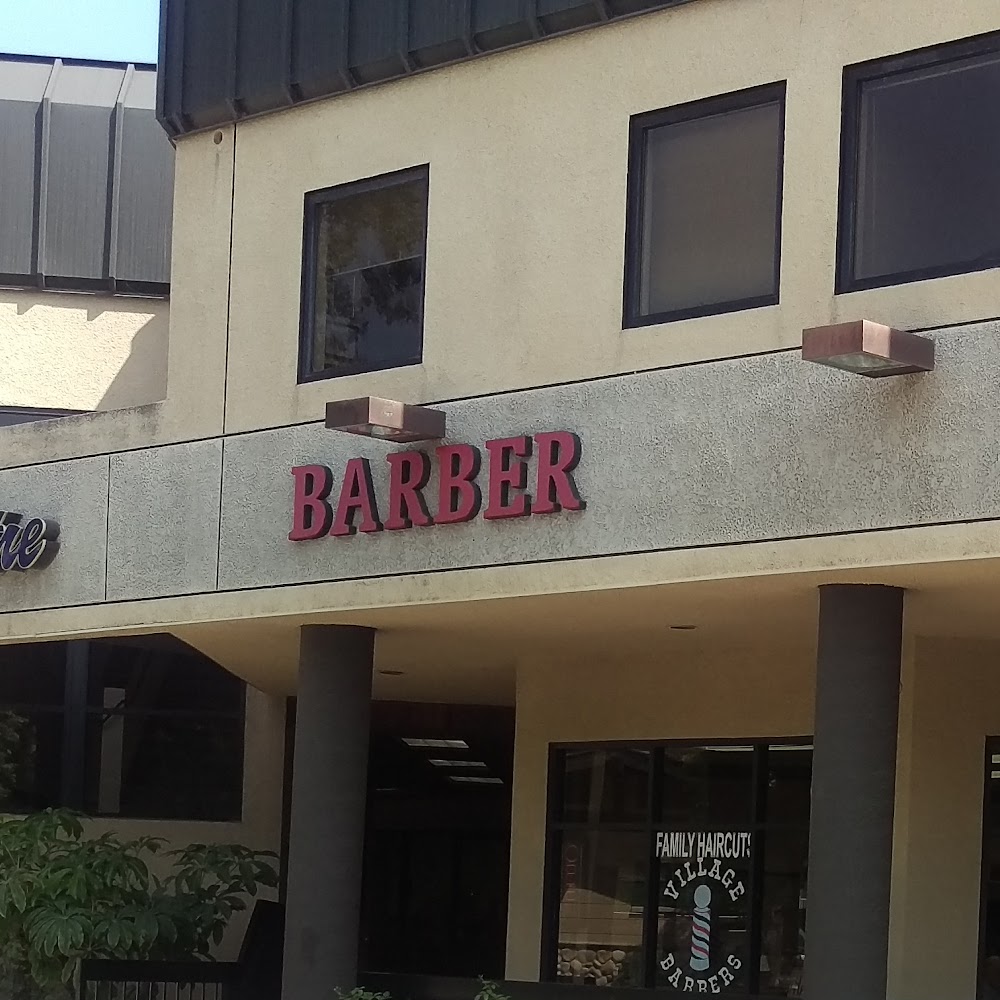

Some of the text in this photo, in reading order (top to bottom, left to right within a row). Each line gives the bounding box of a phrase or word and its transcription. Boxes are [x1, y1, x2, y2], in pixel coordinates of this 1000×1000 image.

[289, 431, 587, 541] BARBER
[656, 832, 696, 858] FAMILY
[664, 857, 745, 901] VILLAGE
[660, 953, 742, 994] BARBERS
